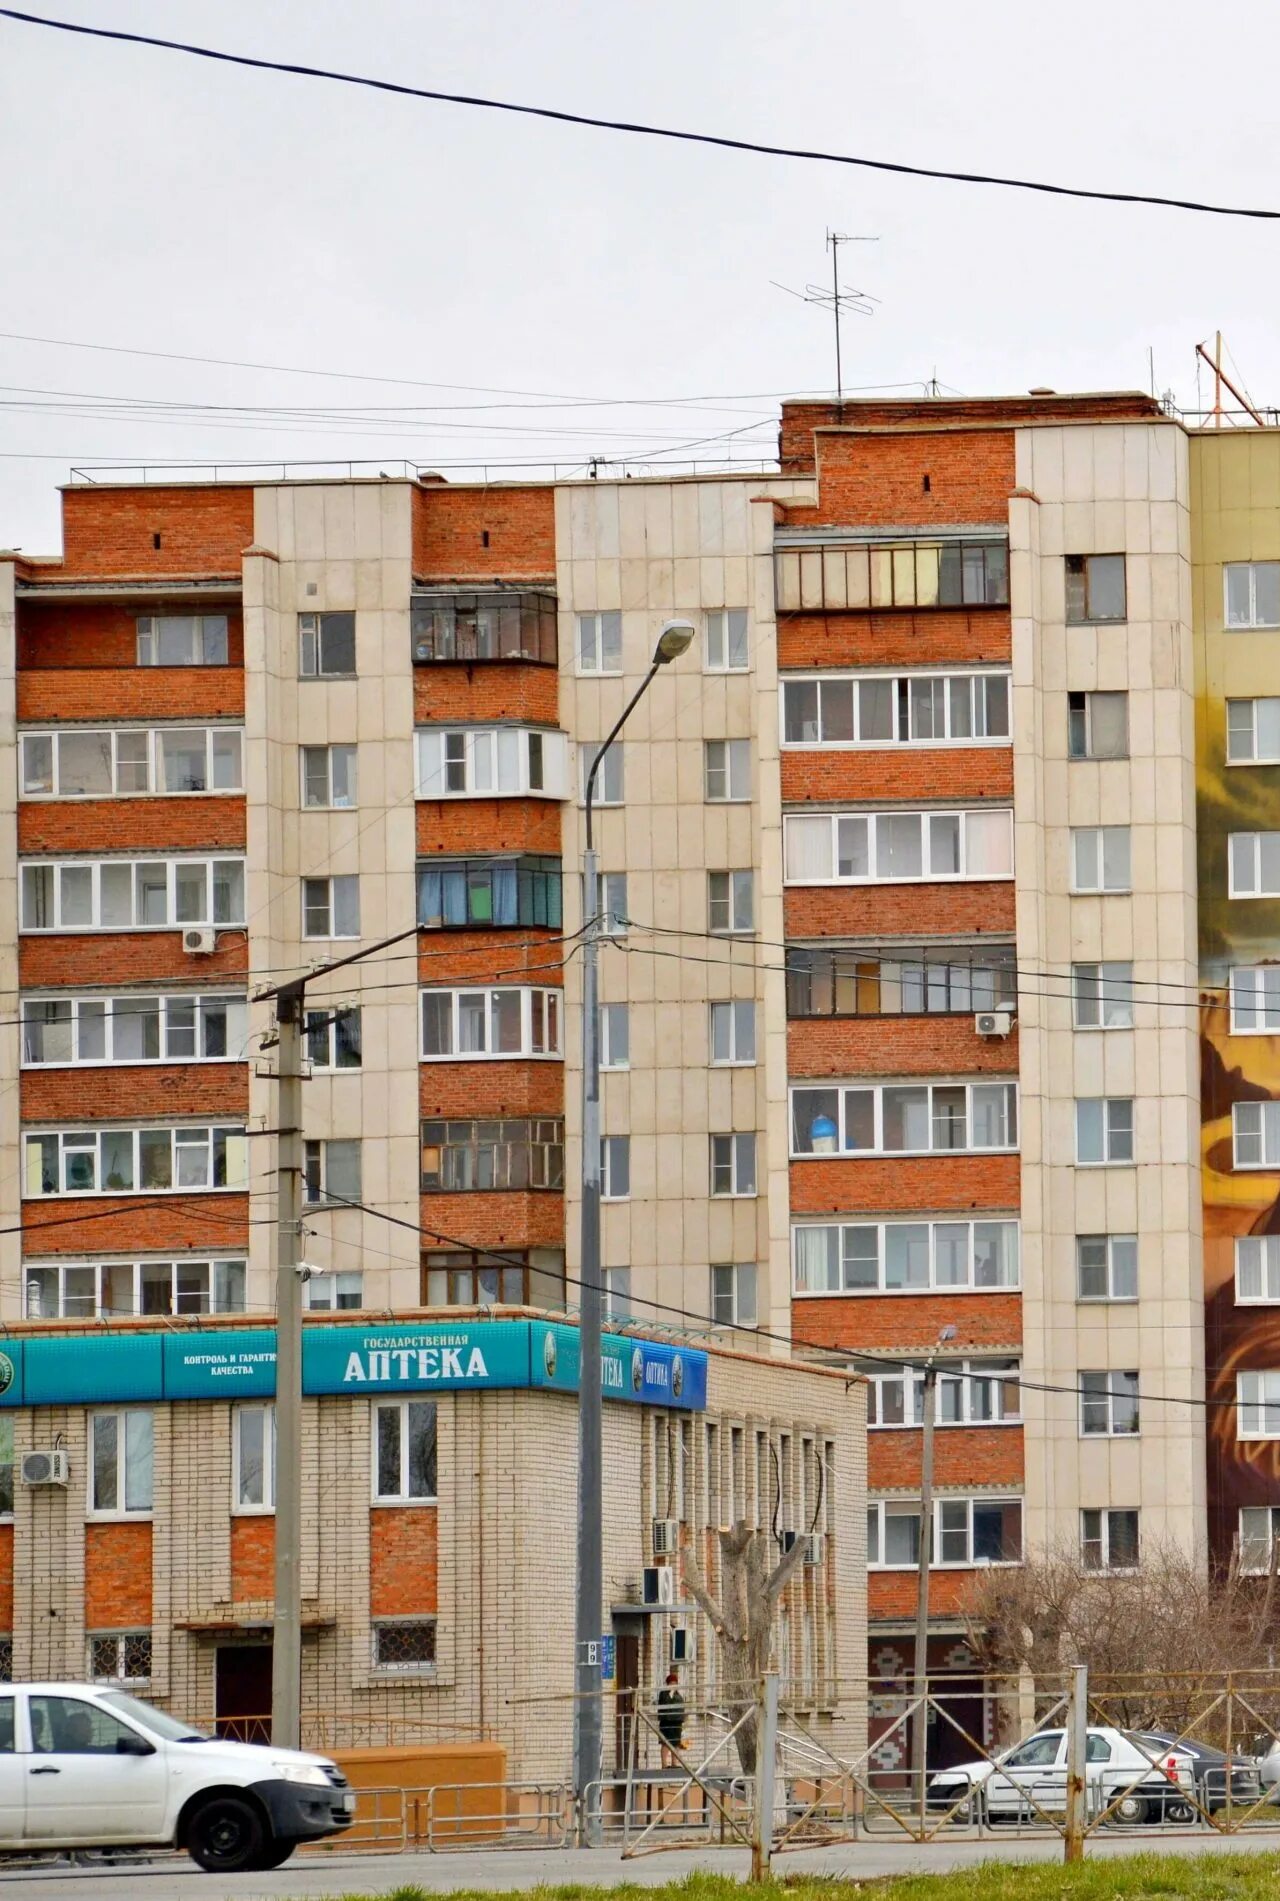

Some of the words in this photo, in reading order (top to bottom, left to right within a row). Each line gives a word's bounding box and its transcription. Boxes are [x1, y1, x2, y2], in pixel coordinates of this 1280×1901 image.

[363, 1335, 469, 1349] ГОСУДАРСТВЕННАЯ
[184, 1354, 227, 1365] КОНТРОЛЬ
[230, 1354, 236, 1363] И
[343, 1347, 489, 1381] АПТЕКА
[211, 1366, 254, 1376] КАЧЕСТВА
[646, 1361, 668, 1386] ОПТИКА
